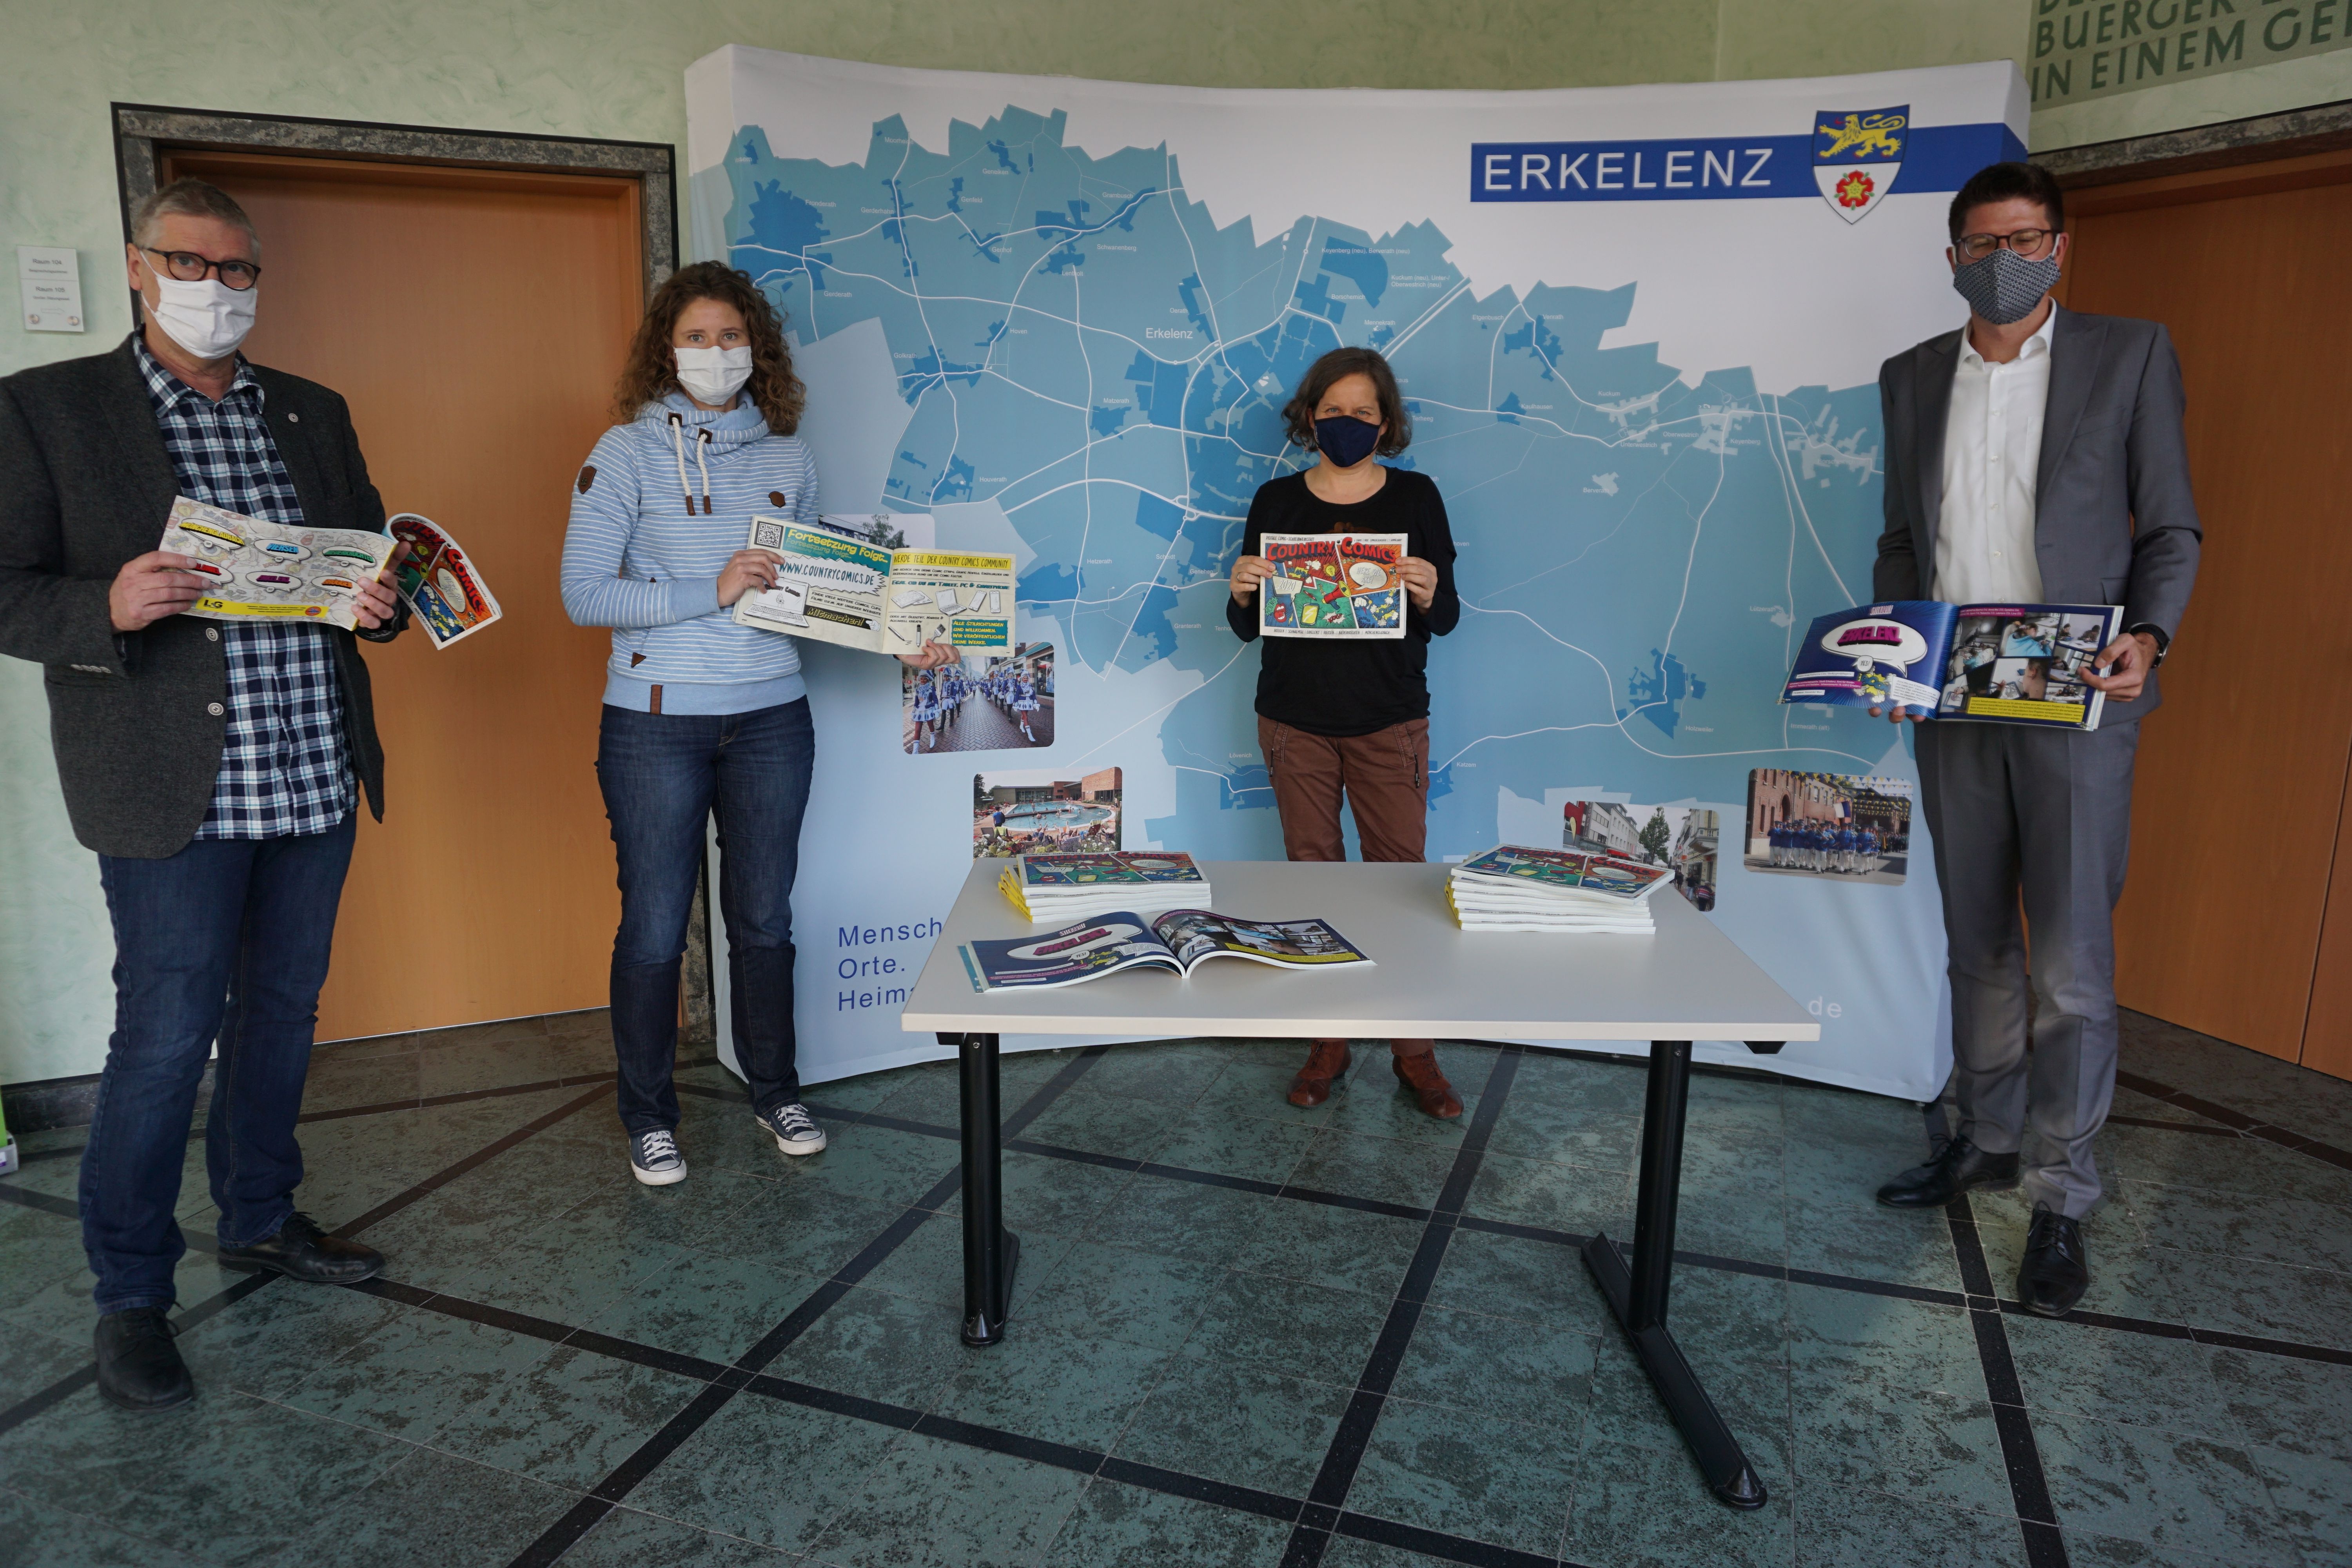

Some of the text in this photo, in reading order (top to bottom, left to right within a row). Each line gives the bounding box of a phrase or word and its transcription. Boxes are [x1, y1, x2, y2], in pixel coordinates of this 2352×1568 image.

[2031, 0, 2352, 102] IN EINEM GE
[1484, 149, 1773, 190] ERKELENZ
[1146, 328, 1193, 339] Erkelenz
[266, 543, 299, 554] VIERSEN
[788, 529, 858, 555] Fortsetzung
[1267, 537, 1396, 563] COUNTRY COMICS
[914, 555, 924, 563] TEIL
[927, 555, 937, 564] DER
[939, 556, 960, 565] COUNTRY
[961, 557, 978, 567] COMICS
[981, 559, 1008, 568] COMMUNITY
[447, 549, 485, 616] COMICS
[779, 562, 875, 586] WWW.COUNTRYCOMICS.DE
[1277, 580, 1296, 591] 2020
[1837, 626, 1902, 647] ERKELENZ
[1027, 854, 1107, 862] COUNTRY
[1501, 848, 1588, 859] COUNTRY
[1593, 857, 1656, 876] COMICS
[1033, 928, 1112, 956] ERKELENZ
[838, 956, 905, 979] Orte.
[838, 986, 916, 1011] Heim
